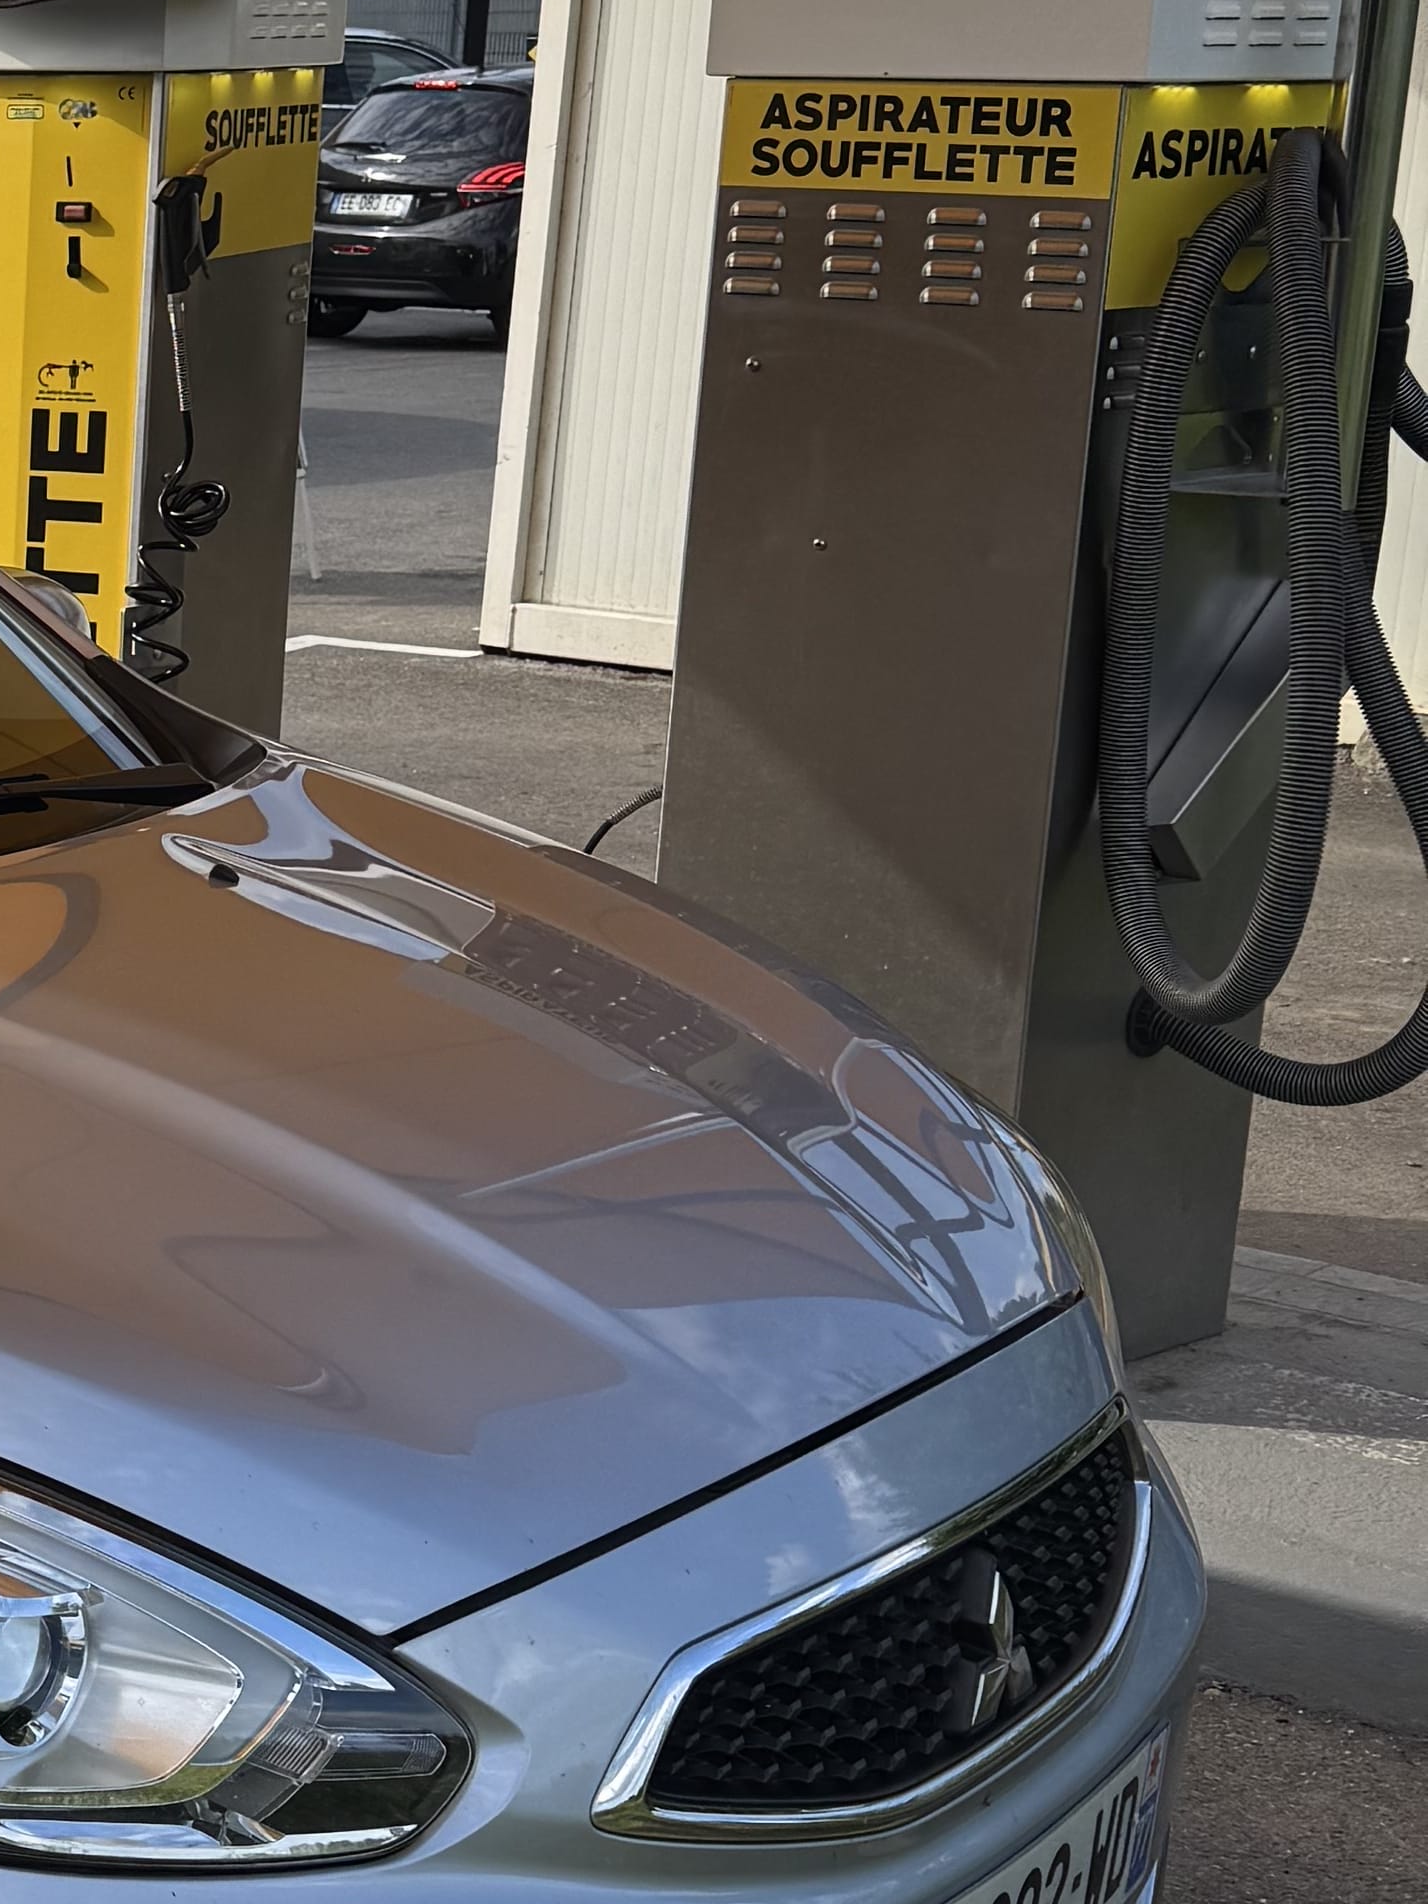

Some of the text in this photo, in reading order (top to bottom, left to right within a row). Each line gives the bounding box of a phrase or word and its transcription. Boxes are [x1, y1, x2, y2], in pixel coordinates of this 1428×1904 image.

[118, 86, 136, 100] CE
[759, 93, 1072, 138] ASPIRATEUR
[205, 103, 319, 152] SOUFFLETTE
[751, 139, 1078, 186] SOUFFLETTE
